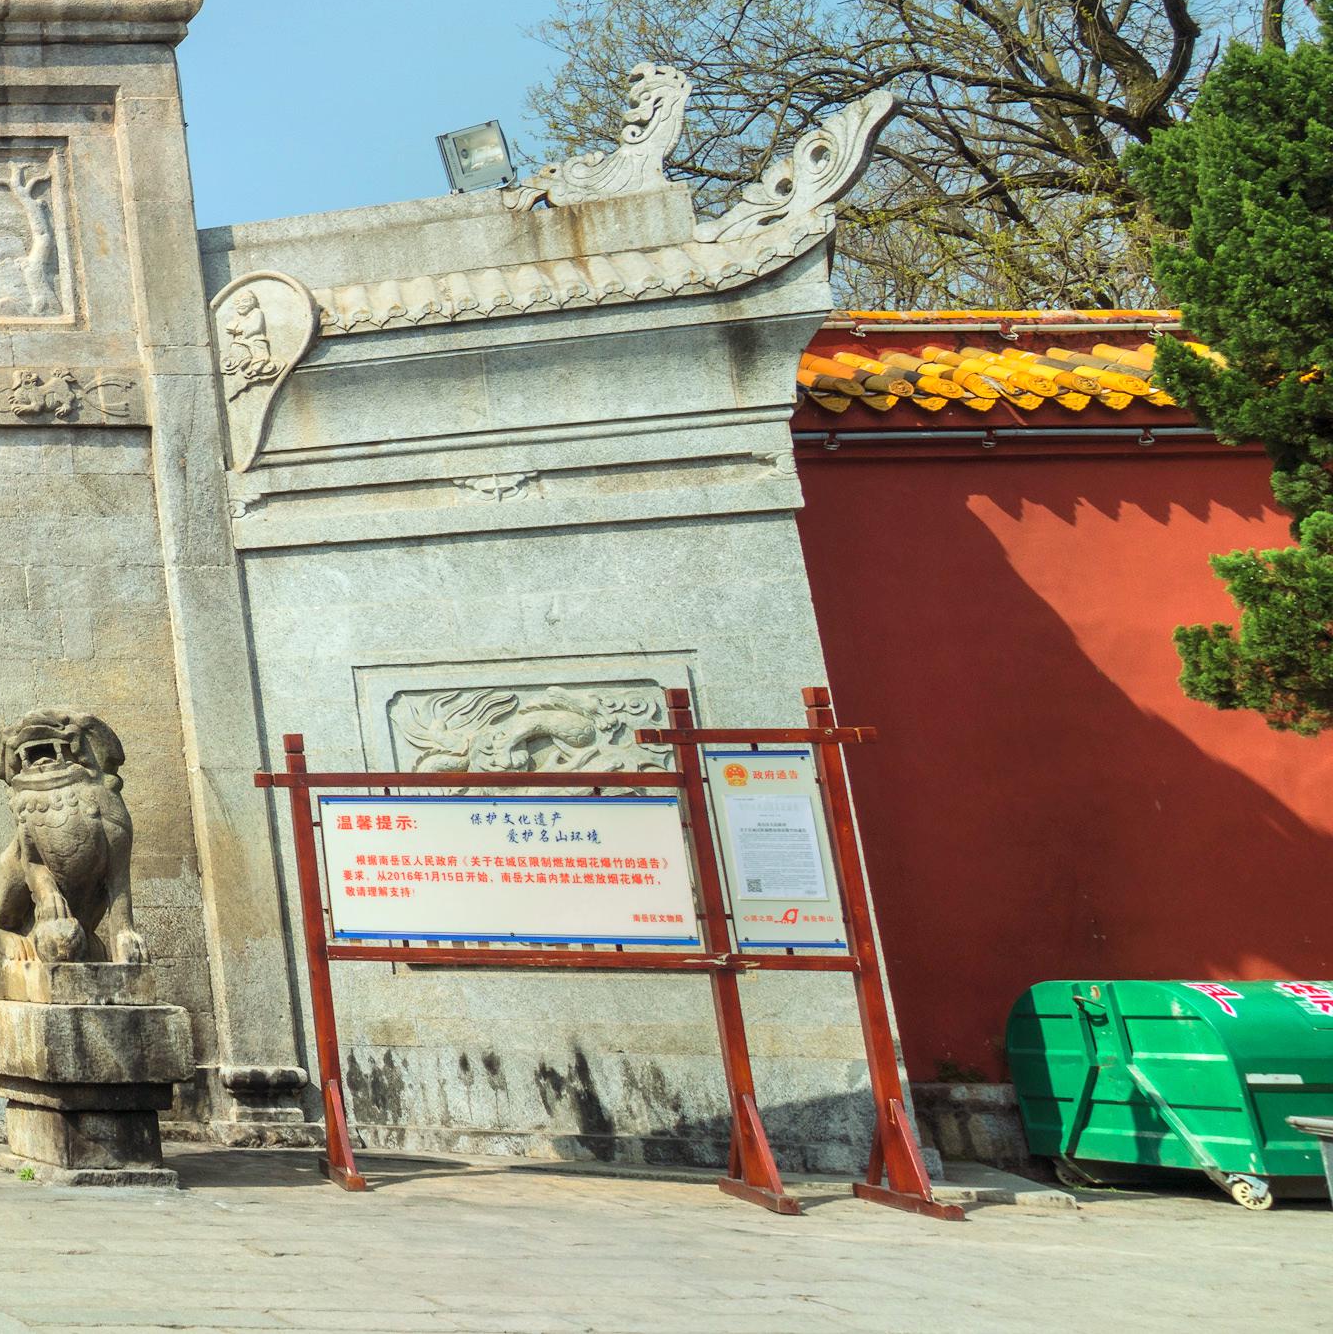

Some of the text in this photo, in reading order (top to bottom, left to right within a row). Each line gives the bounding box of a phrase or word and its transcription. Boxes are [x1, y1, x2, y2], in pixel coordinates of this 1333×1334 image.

[752, 769, 799, 780] 政府通告
[470, 812, 561, 826] 保护文化遗产
[507, 829, 601, 845] 爱护名山环境
